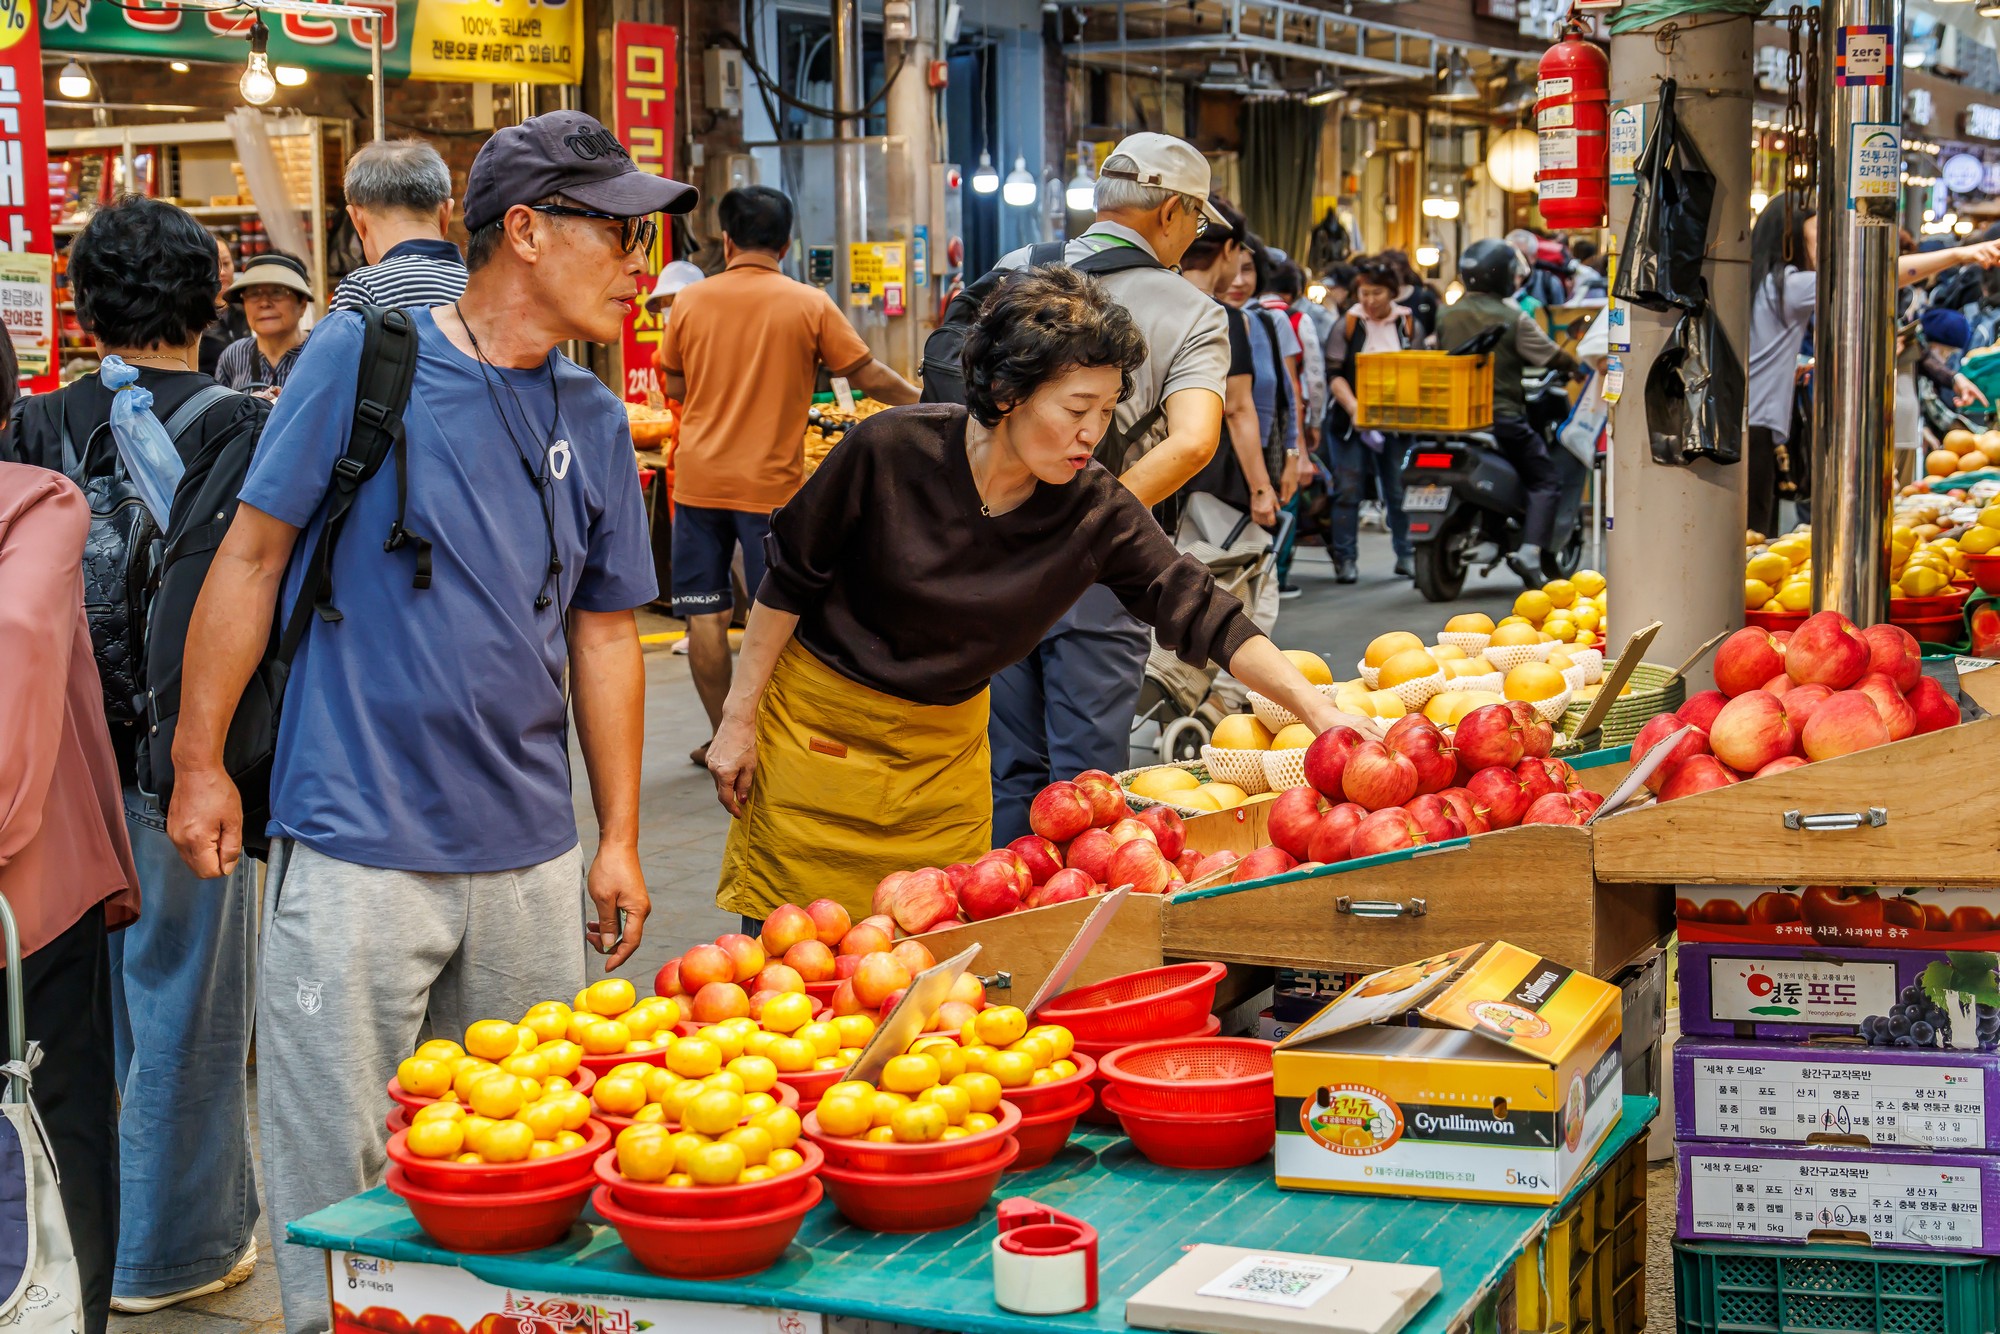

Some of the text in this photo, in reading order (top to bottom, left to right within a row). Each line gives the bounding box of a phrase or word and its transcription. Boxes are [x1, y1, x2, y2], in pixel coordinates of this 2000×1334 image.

[461, 16, 542, 38] 100% 국내산만
[432, 40, 571, 64] 전문으로 취급하고 있습니다
[1852, 48, 1881, 57] zero
[1860, 150, 1898, 164] 전통시장
[1859, 165, 1897, 179] 화재공제
[2, 288, 43, 307] 환급행사
[3, 308, 43, 327] 참여점포
[1775, 926, 1909, 938] 충주하면 사과, 사과하면 충주
[1807, 983, 1857, 1005] 포도
[1726, 1065, 1734, 1074] 후
[1801, 1068, 1872, 1081] 황간구교작목반
[1758, 1087, 1777, 1096] 포도
[1832, 1090, 1860, 1100] 영동군
[1901, 1102, 1920, 1111] 충북
[1923, 1103, 1950, 1112] 영동군
[1415, 1112, 1515, 1135] Gyullimwon
[1853, 1116, 1870, 1126] 보통
[1760, 1126, 1777, 1135] 5kg
[1723, 1163, 1731, 1172] 후
[1799, 1166, 1869, 1179] 황간구교작목반
[1506, 1168, 1539, 1188] 5kg
[1765, 1185, 1783, 1194] 포도
[1830, 1187, 1857, 1198] 영동군
[1898, 1200, 1978, 1213] 충북 영동군 황간면
[1767, 1224, 1784, 1233] 5kg
